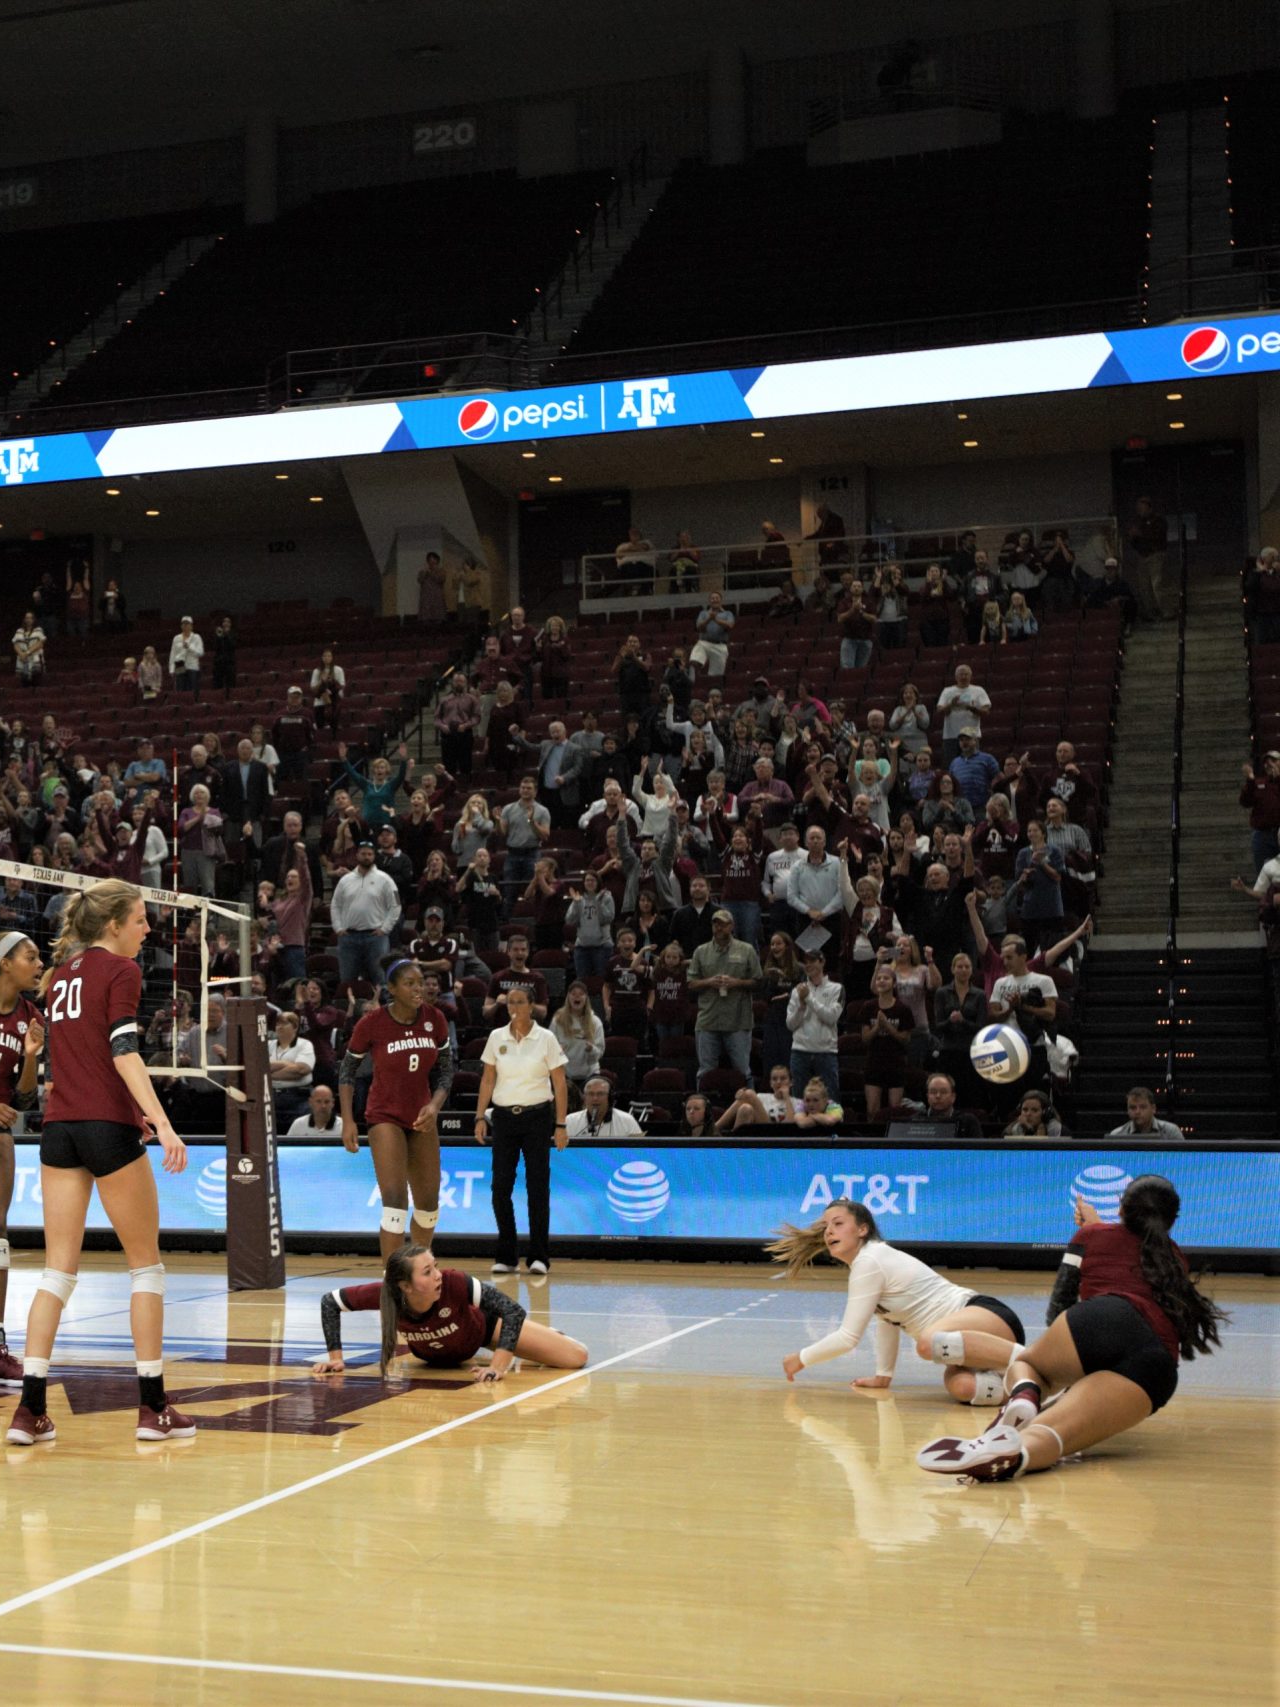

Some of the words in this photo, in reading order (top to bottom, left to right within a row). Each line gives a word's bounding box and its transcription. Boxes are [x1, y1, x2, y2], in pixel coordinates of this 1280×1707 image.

[413, 122, 475, 151] 220
[503, 394, 583, 432] pepsi
[819, 477, 848, 490] 121
[268, 541, 296, 553] 120
[51, 976, 83, 1022] 20
[387, 1037, 436, 1054] CAROLINA
[409, 1053, 420, 1072] 8
[441, 1119, 462, 1129] POSS
[263, 1073, 281, 1258] AGGIES
[799, 1173, 930, 1215] AT&T
[399, 1322, 459, 1342] CAROLINA
